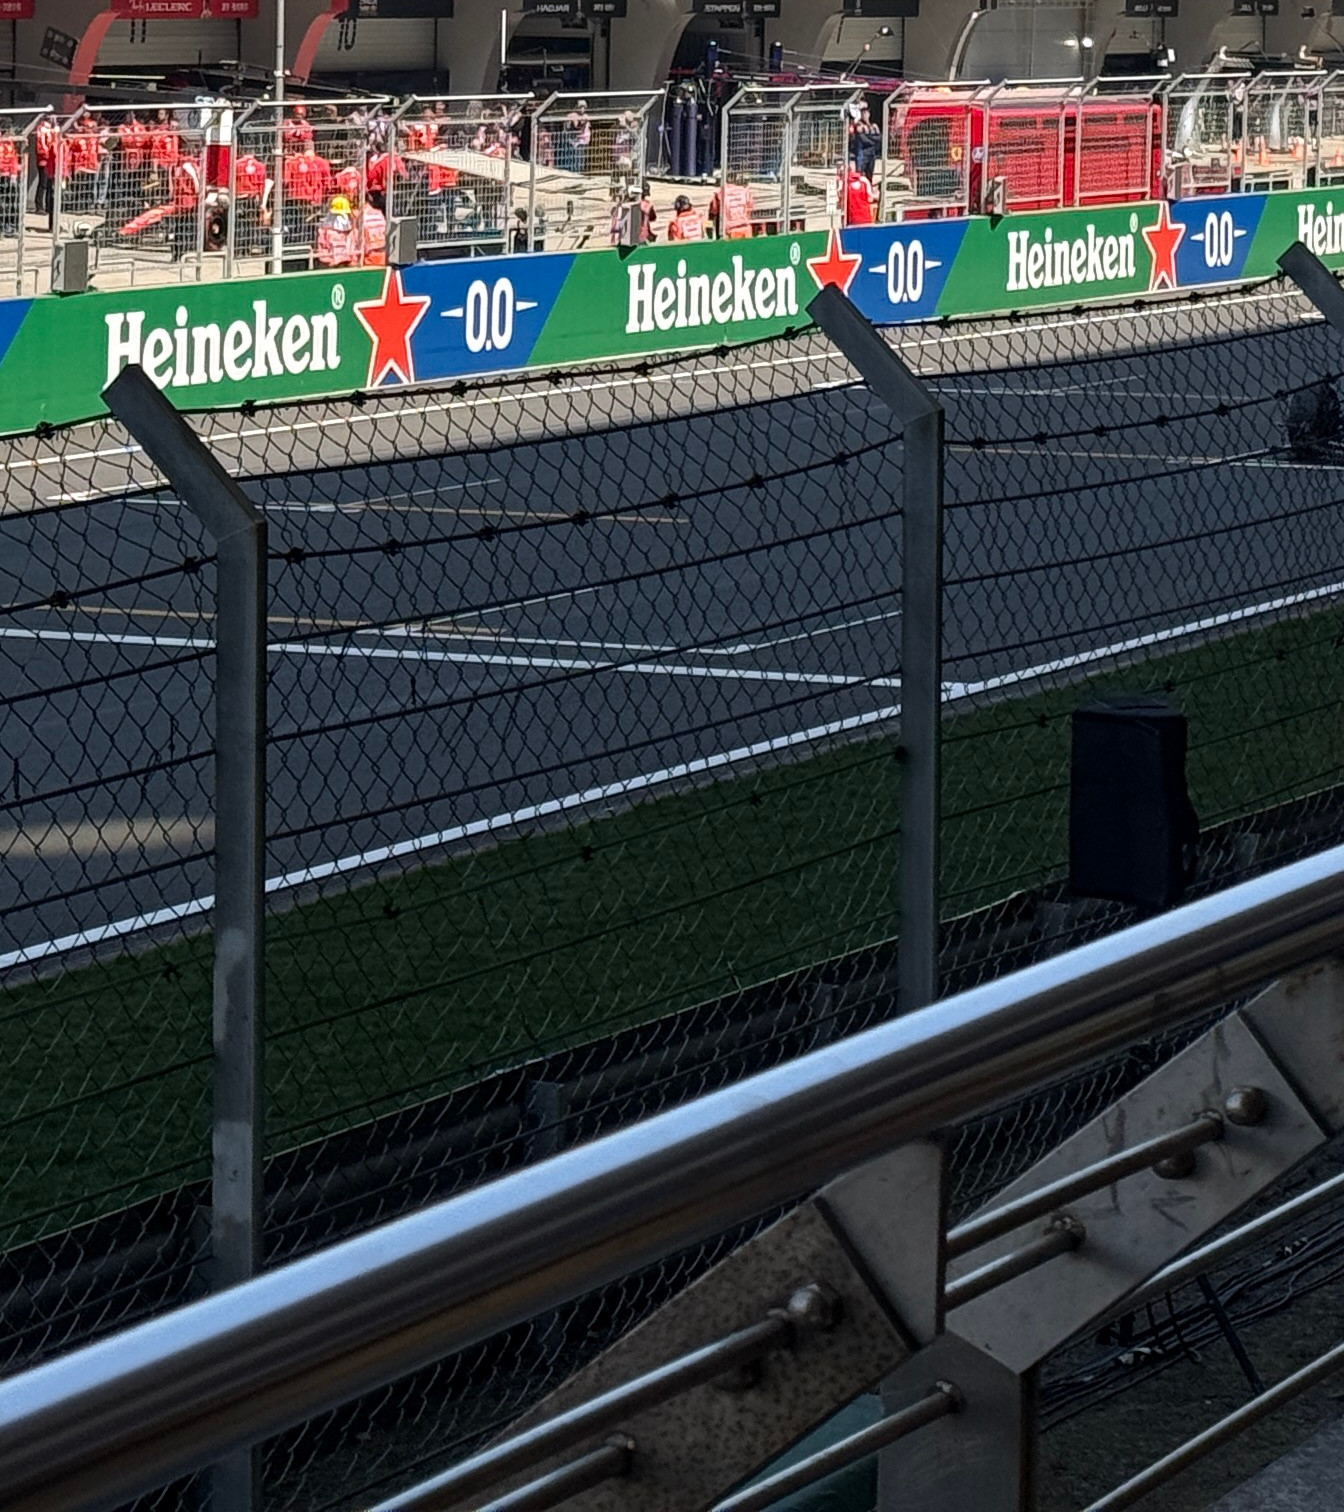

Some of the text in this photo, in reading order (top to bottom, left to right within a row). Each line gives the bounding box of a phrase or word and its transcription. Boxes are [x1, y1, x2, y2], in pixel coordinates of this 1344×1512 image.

[145, 1, 193, 13] LECLERC
[1204, 211, 1233, 268] 0.0
[885, 239, 925, 305] 0.0
[465, 277, 515, 352] 0.0
